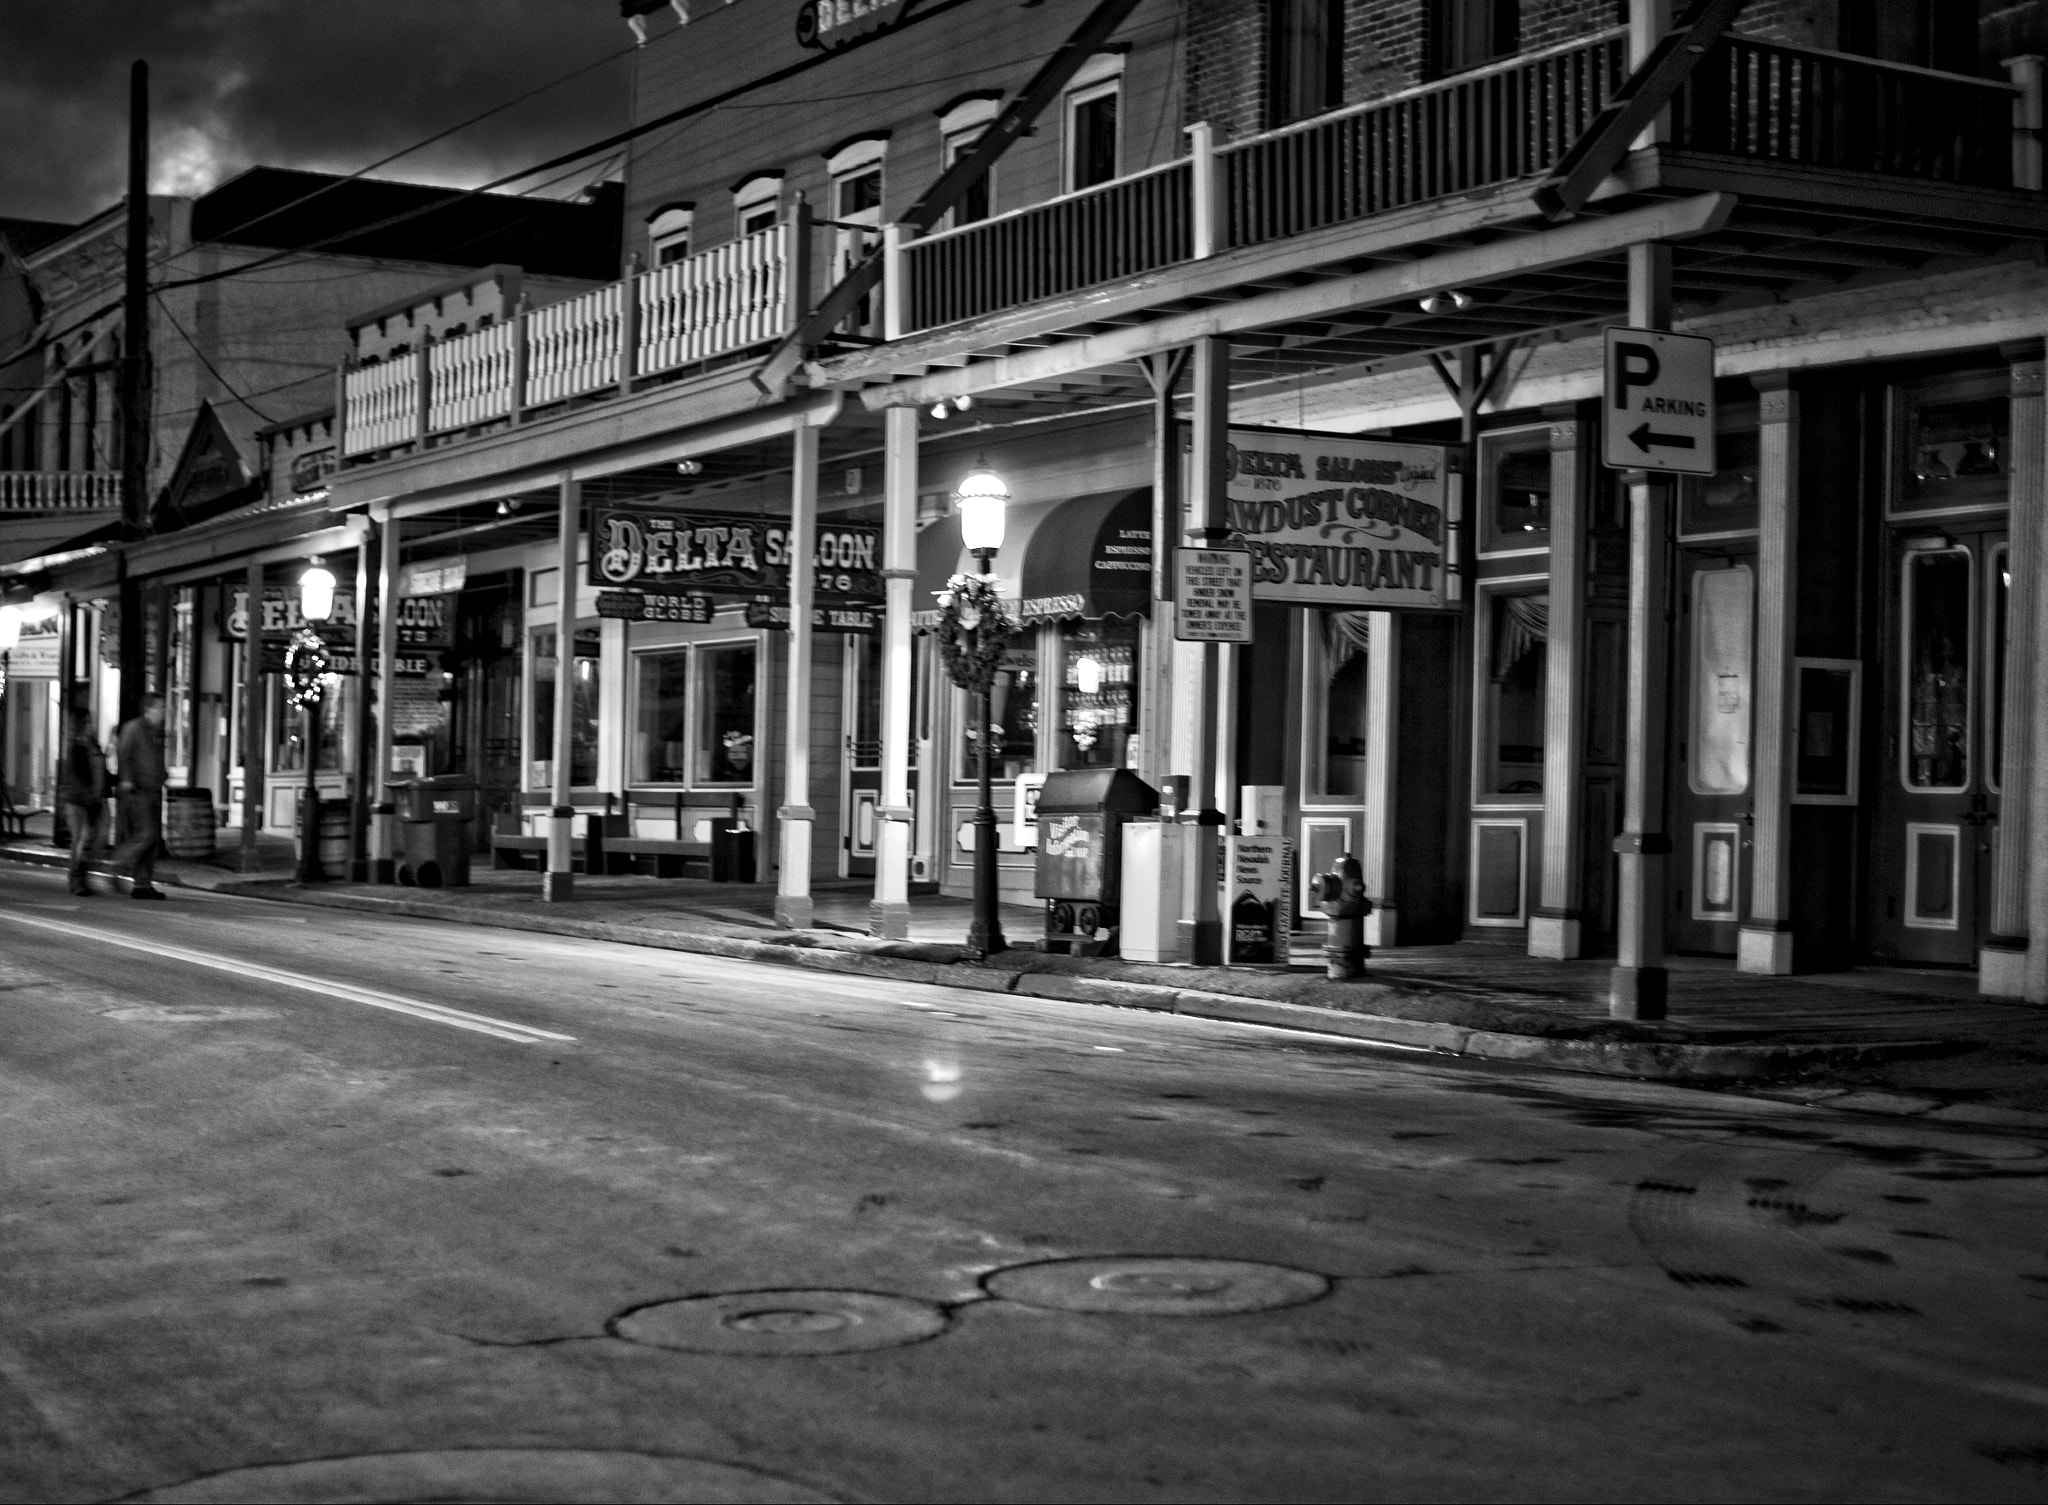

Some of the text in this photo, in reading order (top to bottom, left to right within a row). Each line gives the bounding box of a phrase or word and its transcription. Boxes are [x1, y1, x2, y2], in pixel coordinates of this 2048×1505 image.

[818, 0, 897, 33] DEL
[650, 519, 674, 529] THE
[1226, 487, 1442, 546] AWDUST CORNER
[601, 519, 875, 582] DELTA SOON
[1230, 533, 1440, 590] ESTAURANT
[642, 594, 706, 608] WORLD
[1021, 594, 1085, 616] ESPRESSO
[227, 592, 356, 637] DELA
[643, 607, 706, 621] GLOBE
[828, 610, 874, 628] TABLE
[1236, 844, 1272, 853] Northern
[1278, 837, 1291, 882] JOURNAL
[1236, 865, 1259, 874] News
